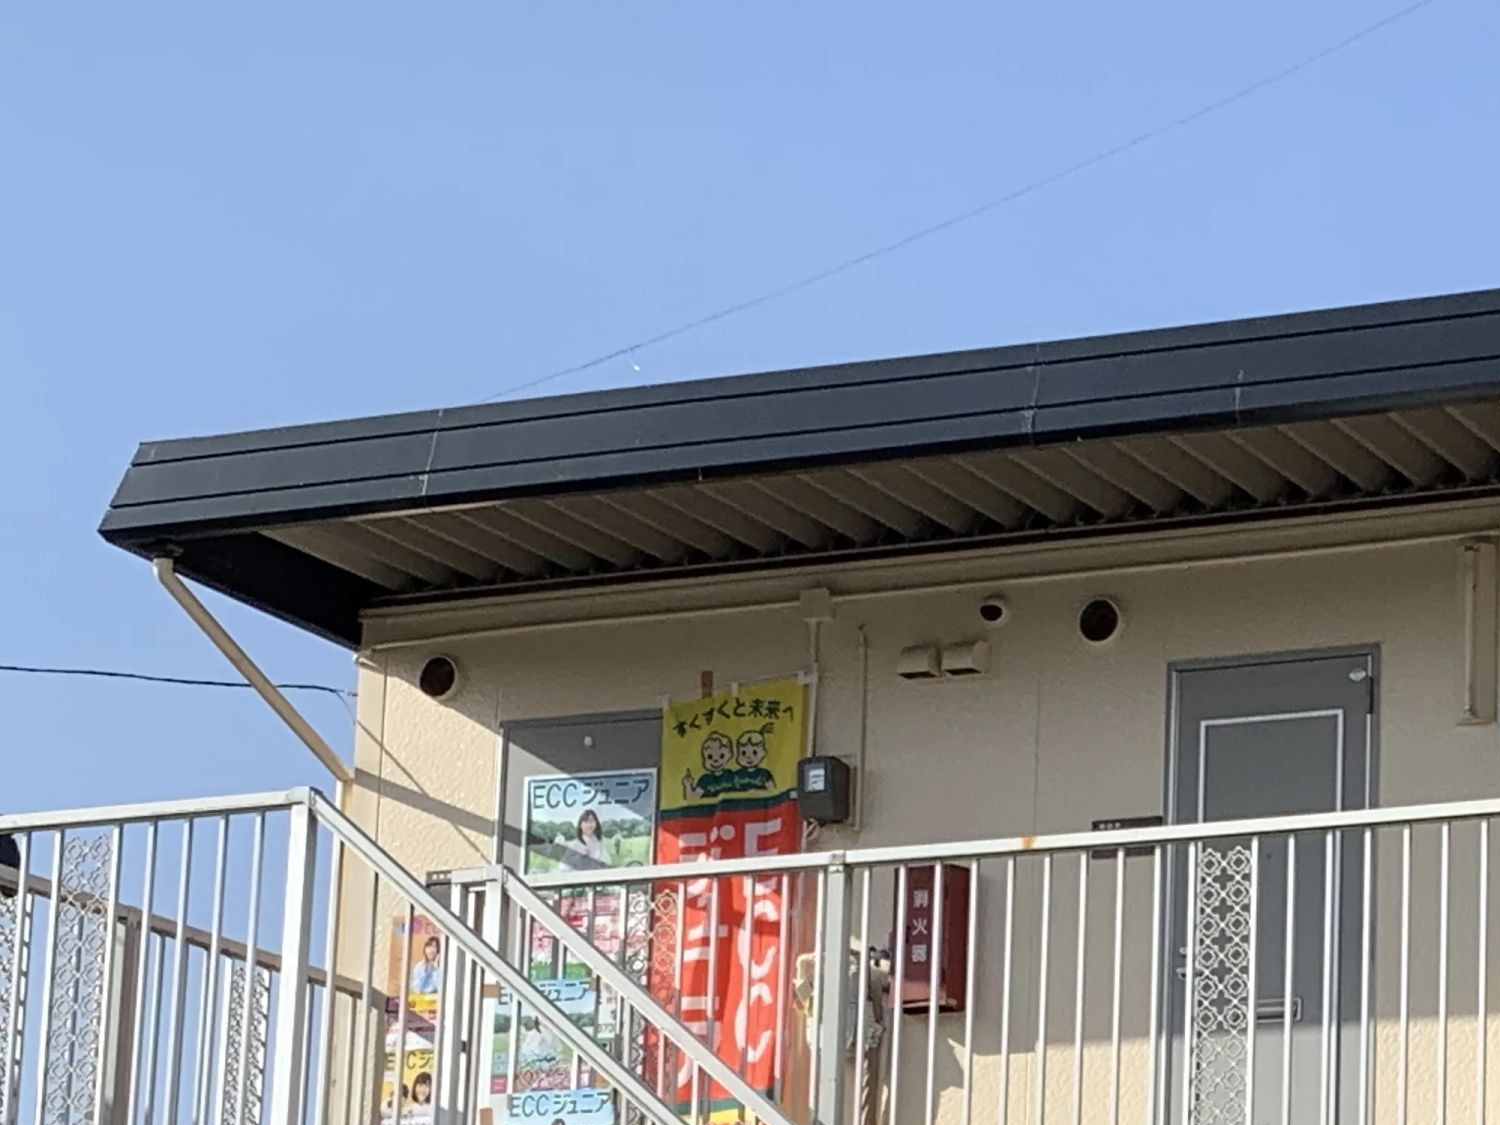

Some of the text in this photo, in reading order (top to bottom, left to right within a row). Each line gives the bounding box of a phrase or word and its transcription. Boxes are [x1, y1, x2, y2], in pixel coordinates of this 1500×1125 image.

[532, 779, 650, 809] ECCジュニア
[509, 1092, 611, 1118] ECCジュニア
